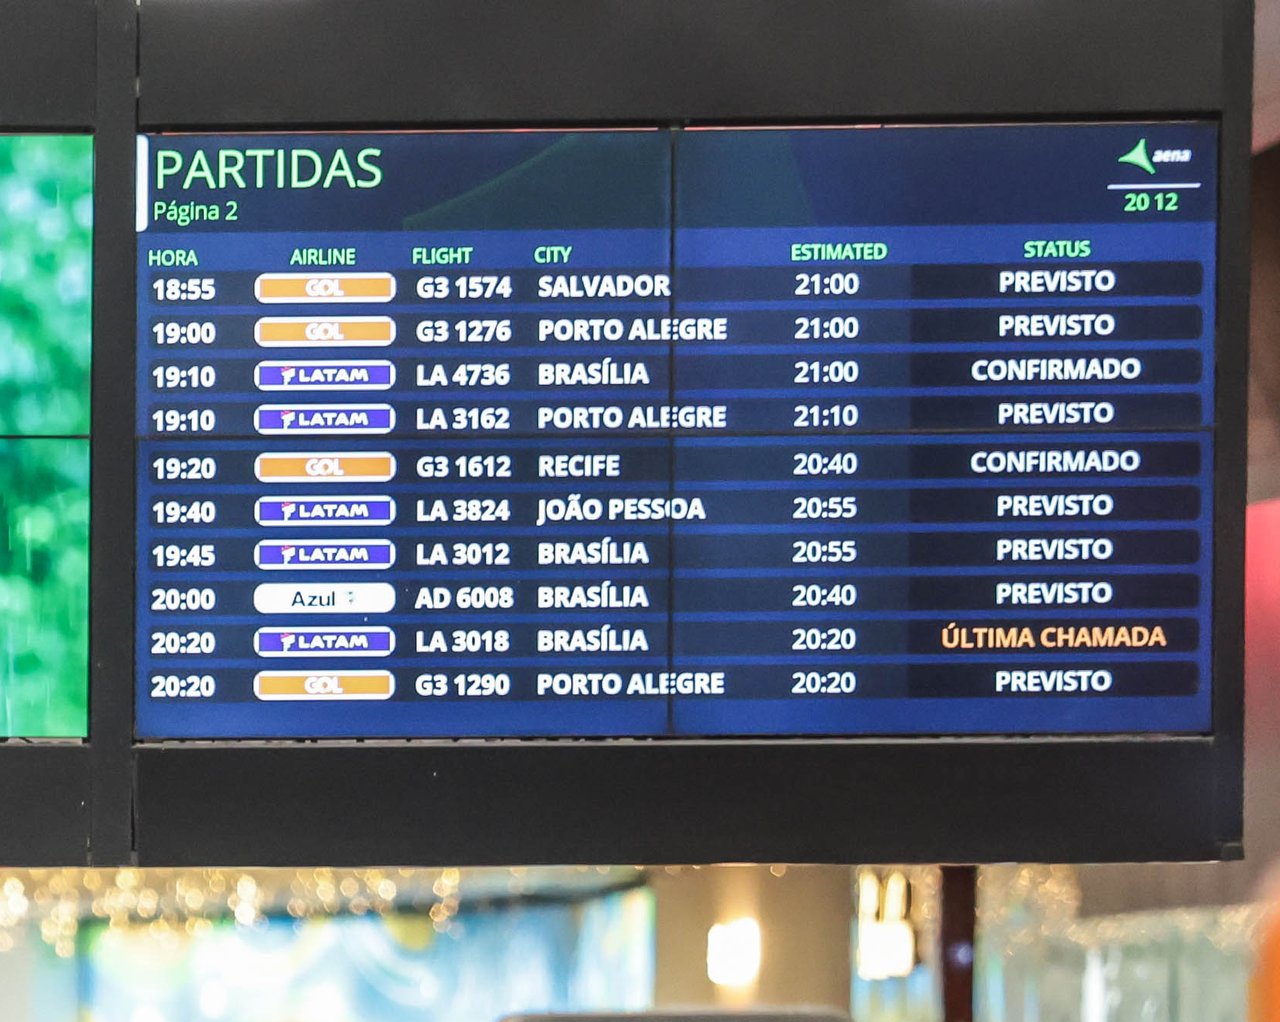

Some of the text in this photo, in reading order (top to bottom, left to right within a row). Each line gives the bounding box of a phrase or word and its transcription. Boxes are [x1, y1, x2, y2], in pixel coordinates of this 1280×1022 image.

[157, 147, 382, 190] PARTIDAS
[1152, 149, 1192, 163] aena
[154, 199, 238, 227] Página 2
[148, 239, 1092, 267] HORA AIRLINE FLIGHT CITY ESTIMATED STATUS
[152, 269, 1116, 301] 18:55 GOL G3 1574 SALVADOR 21:00 PREVISTO
[152, 313, 1115, 345] 19:00 GOL G3 1276 PORTO ALEGRE 21:00 PREVISTO
[152, 357, 1142, 388] 19:10 LATAM LA 4736 BRASÍLIA 21:00 CONFIRMADO
[152, 450, 1141, 480] 19:20 G3 1612 RECIFE 20:40 CONFIRMADO
[152, 493, 1114, 527] 19:40 LATAM LA 3824 JOÃO PESSOA 20:55 PREVISTO
[150, 580, 1113, 611] 20:00 Azul AD 6008 BRASÍLIA 20:40 PREVISTO
[150, 622, 1167, 654] 20:20 LATAM LA 3018 BRASÍLIA 20:20 ÚLTIMA CHAMADA
